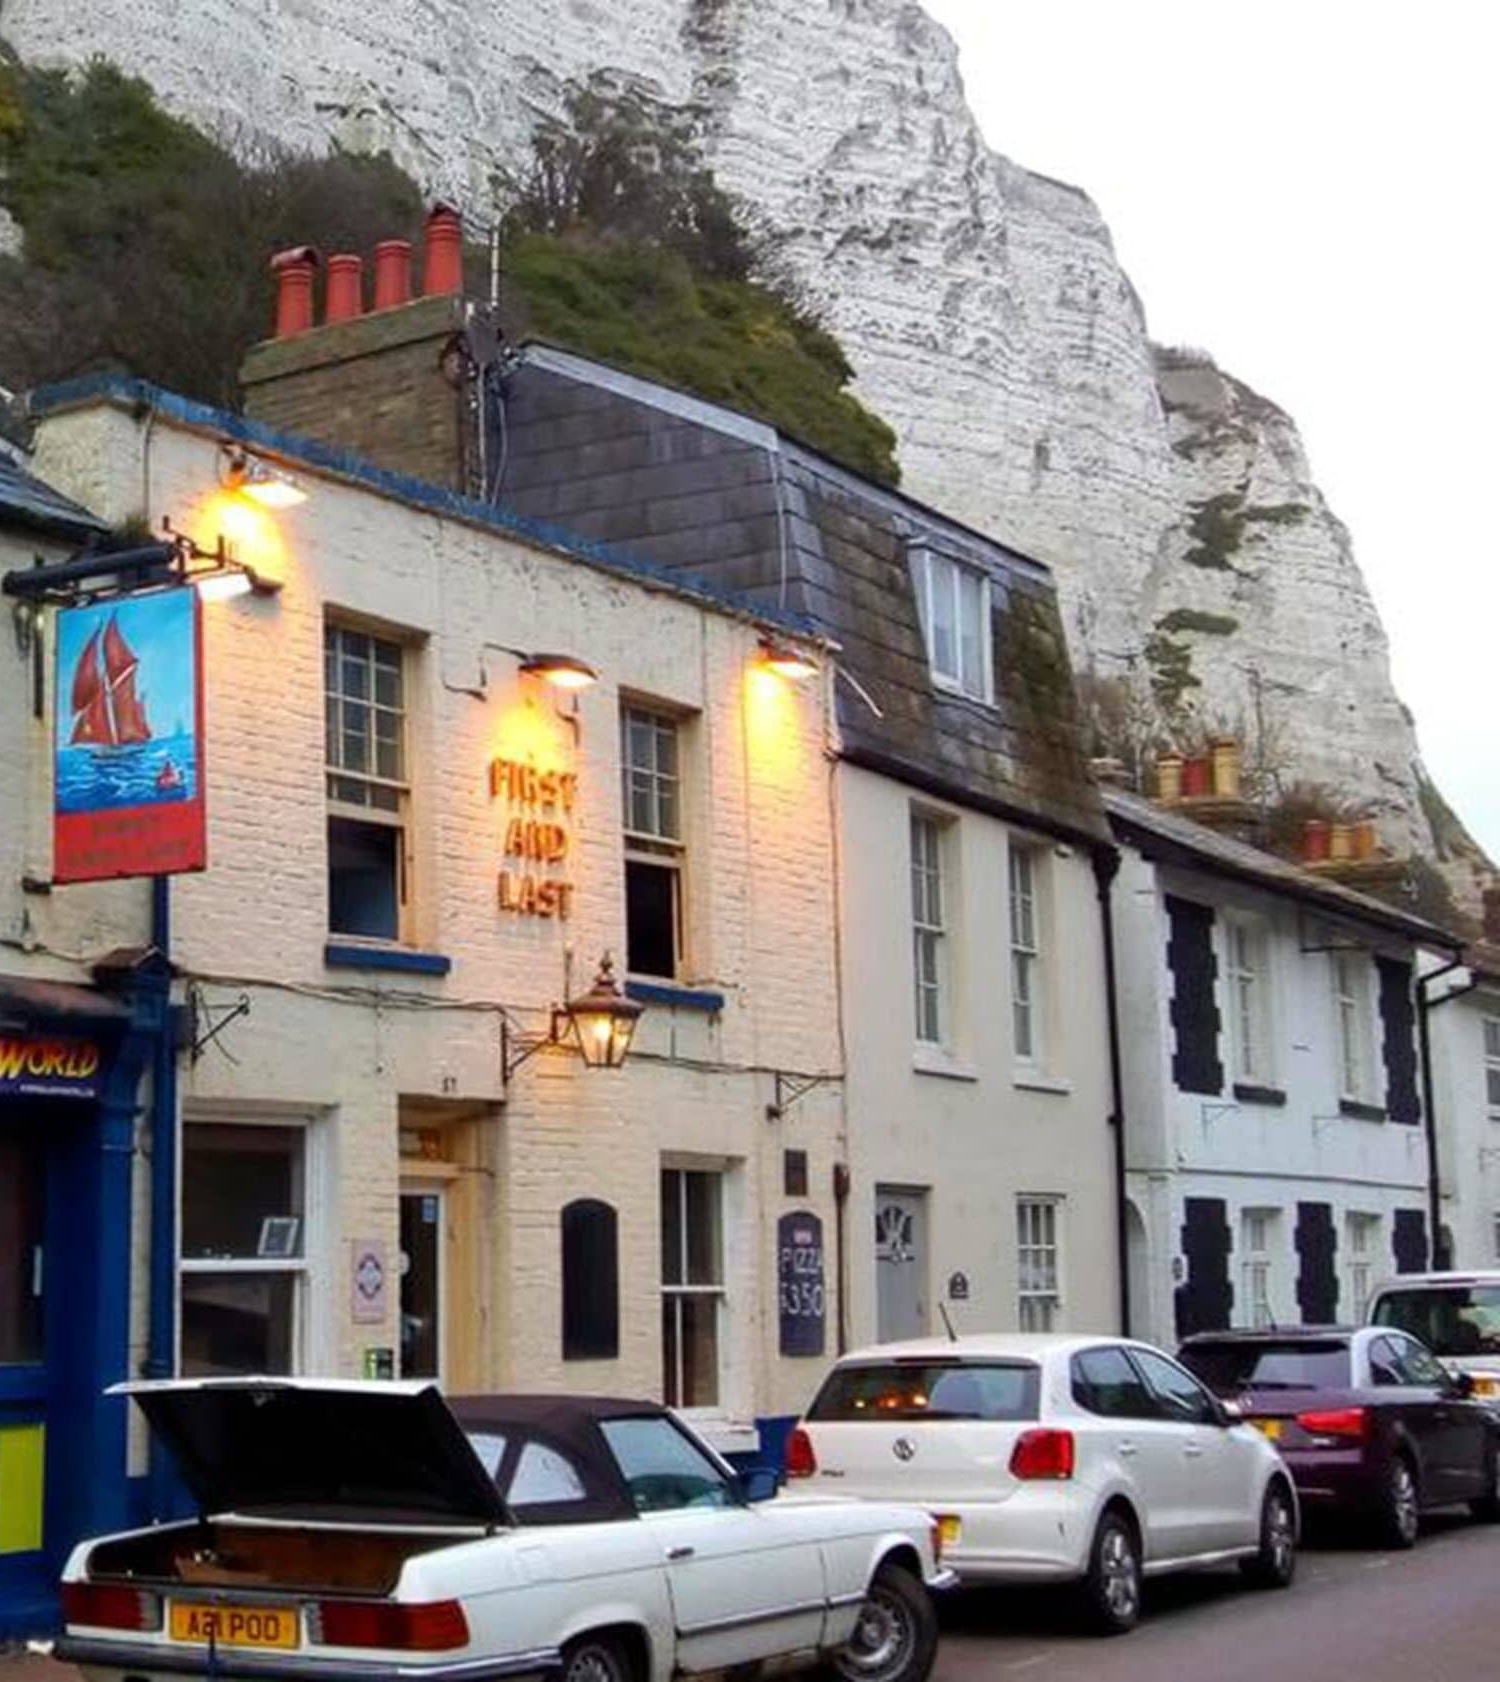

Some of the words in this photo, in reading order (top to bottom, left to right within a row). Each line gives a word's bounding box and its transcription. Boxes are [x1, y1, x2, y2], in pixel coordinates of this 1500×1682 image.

[489, 758, 577, 813] FIRST
[504, 818, 567, 863] AND
[498, 872, 574, 921] LAST
